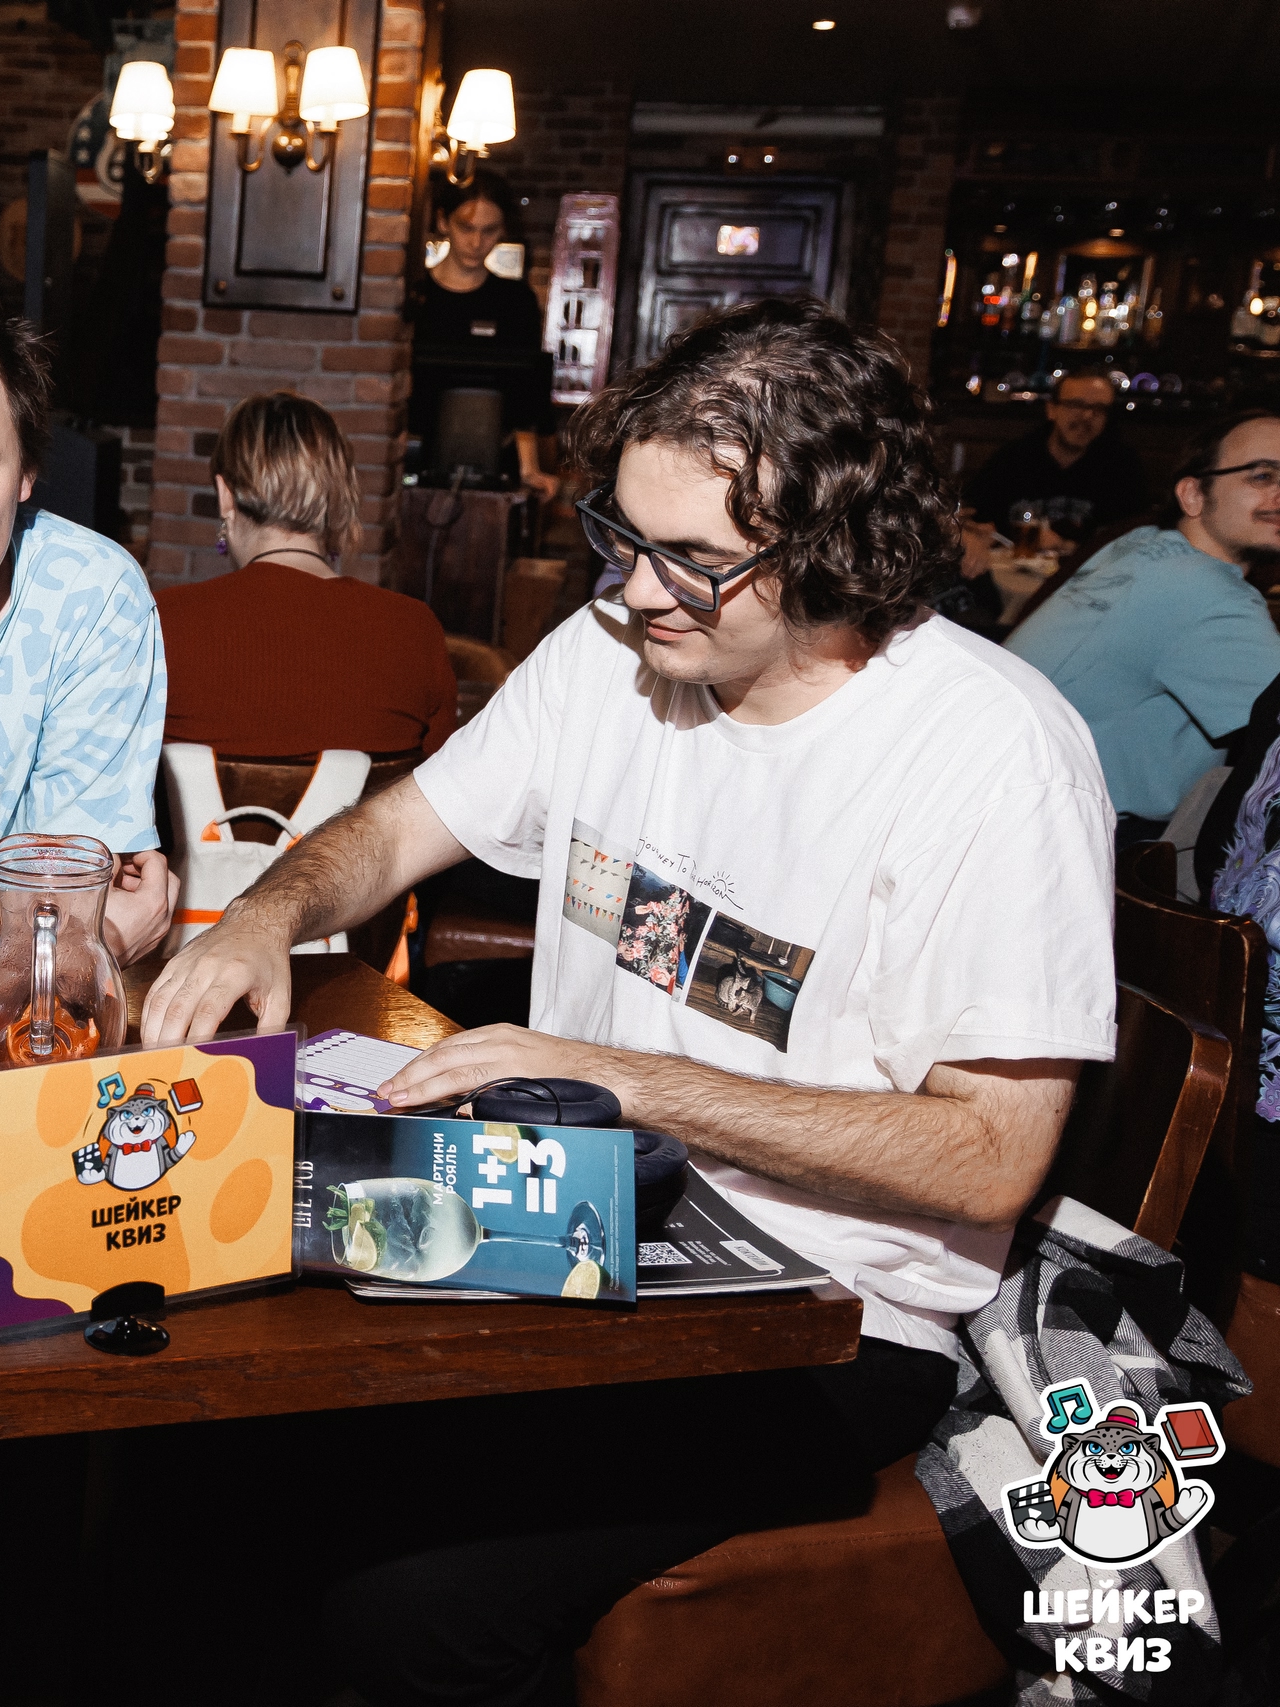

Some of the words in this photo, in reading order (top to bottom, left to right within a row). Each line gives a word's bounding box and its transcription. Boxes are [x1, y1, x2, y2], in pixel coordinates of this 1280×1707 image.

[294, 1160, 314, 1190] PUB
[432, 1132, 444, 1205] МАРТИНИ
[445, 1143, 457, 1194] РОЯЛЬ
[472, 1134, 512, 1209] 1+1
[517, 1138, 567, 1214] =3
[91, 1194, 182, 1228] ШЕЙКЕР
[106, 1223, 166, 1252] КВИЗ
